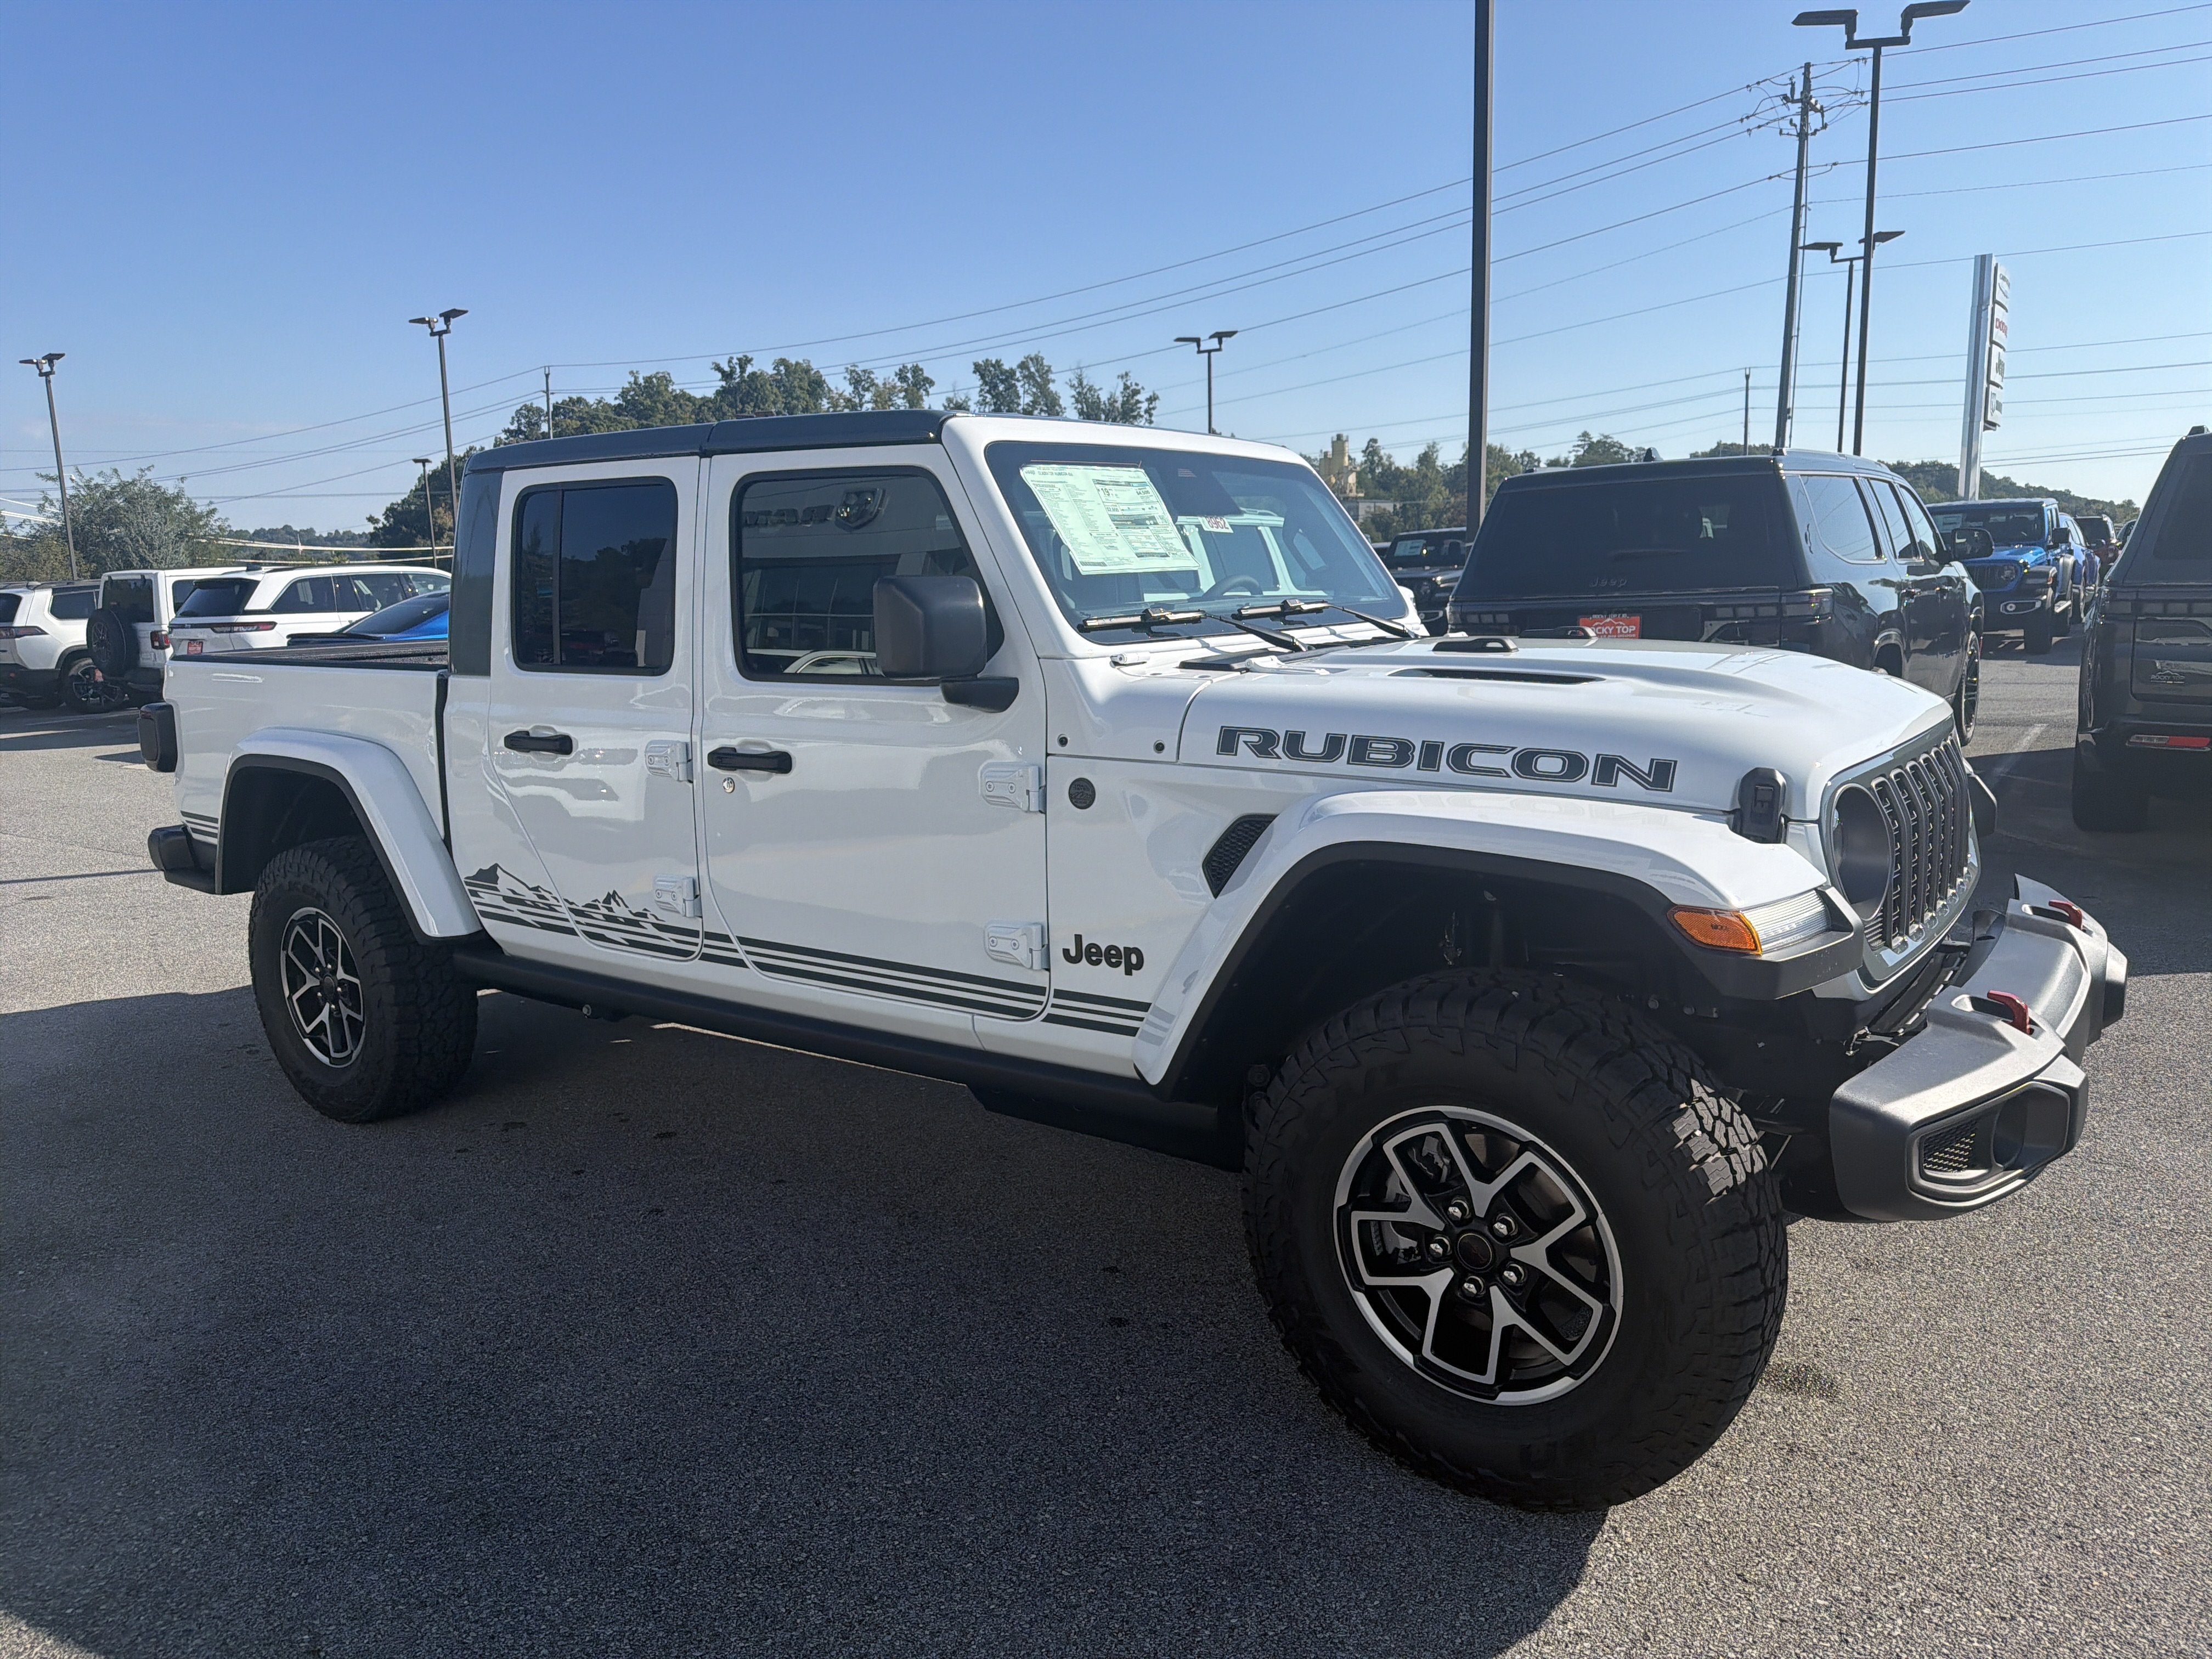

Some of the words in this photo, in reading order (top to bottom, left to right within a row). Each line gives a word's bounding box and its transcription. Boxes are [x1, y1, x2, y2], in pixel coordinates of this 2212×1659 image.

[1204, 516, 1229, 530] 8962
[1616, 625, 1637, 634] TOP
[1216, 725, 1678, 793] RUBICON
[1062, 934, 1144, 976] Jeep
